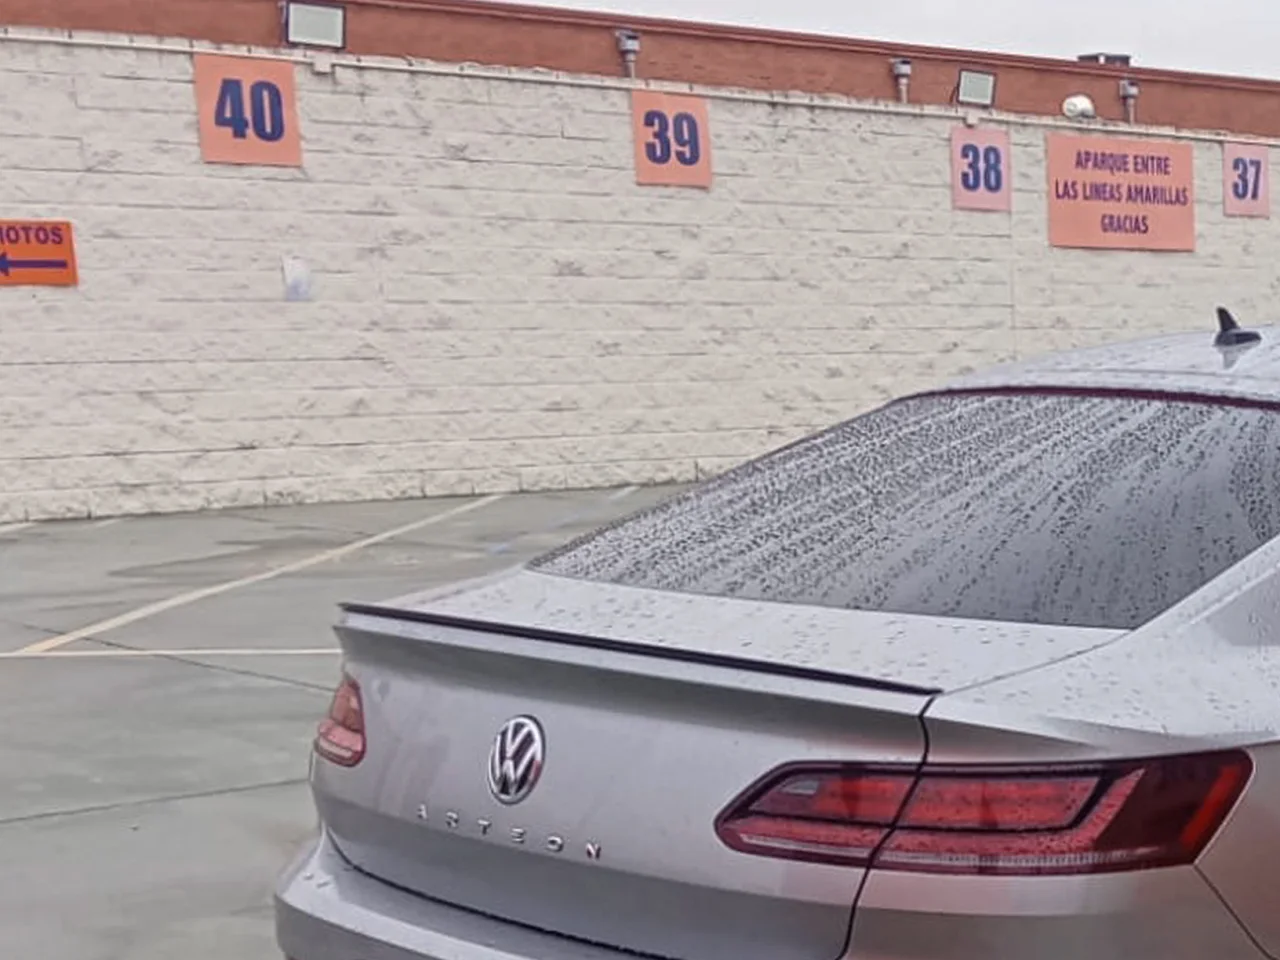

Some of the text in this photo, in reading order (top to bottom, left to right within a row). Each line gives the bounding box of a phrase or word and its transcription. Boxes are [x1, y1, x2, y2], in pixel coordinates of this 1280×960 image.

[214, 78, 286, 142] 40
[643, 109, 701, 167] 39
[960, 143, 1003, 194] 38
[1075, 149, 1171, 176] APARQUE ENTRE
[1232, 156, 1262, 201] 37
[1055, 178, 1188, 206] LAS LINEAS AMARILLAS
[1100, 213, 1149, 234] GRACIAS
[416, 803, 602, 860] ARTEON
